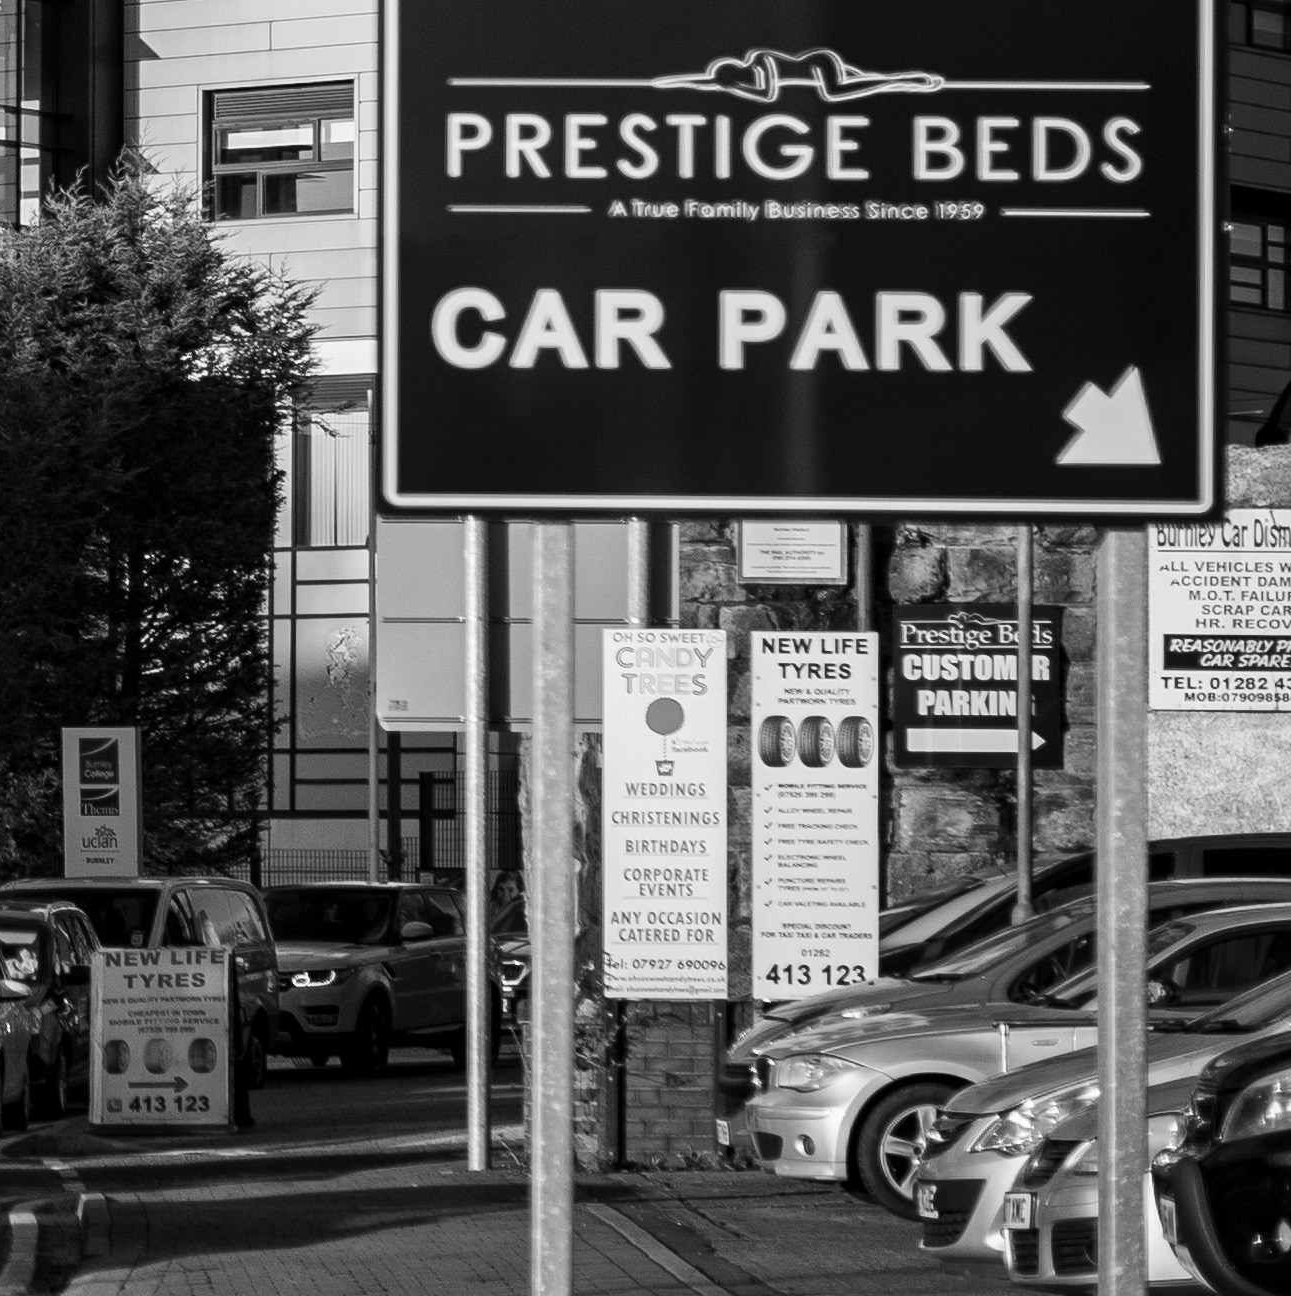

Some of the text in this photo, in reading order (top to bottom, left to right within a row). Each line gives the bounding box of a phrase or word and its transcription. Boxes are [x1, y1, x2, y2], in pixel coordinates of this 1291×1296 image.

[446, 113, 1144, 183] PRESTIGE BEDS
[608, 198, 986, 222] A True Family Business Since 1959
[431, 286, 1034, 373] CAR PARK
[1156, 522, 1216, 548] Burnley
[1221, 518, 1249, 548] Car
[1159, 561, 1189, 573] ALL
[1194, 561, 1274, 573] VEHICLES
[1170, 575, 1252, 587] ACCIDENT
[1188, 590, 1235, 601] M.O.T.
[1201, 604, 1254, 616] SCRAP
[1195, 618, 1225, 629] HR.
[612, 632, 706, 644] OH SO SWEET
[900, 623, 993, 651] Prestige
[762, 637, 869, 655] NEW LIFE
[1169, 638, 1274, 653] REASONABLY
[615, 646, 714, 669] CANDY
[1199, 653, 1235, 667] CAR
[777, 662, 852, 680] TYRES
[902, 653, 1051, 681] CUSTOMR
[621, 673, 708, 696] TREES
[1160, 676, 1203, 690] TEL:
[1209, 677, 1268, 691] 01282
[813, 688, 851, 696] QUALITY
[917, 689, 1037, 717] PARKIN
[83, 769, 115, 780] College
[625, 782, 706, 797] WEDDINGS
[611, 810, 721, 825] CHRISTENINGS
[81, 833, 119, 849] uclan
[625, 839, 707, 854] BIRTHDAYS
[85, 856, 115, 865] BURNLEY
[623, 867, 709, 882] CORPORATE
[639, 882, 694, 897] EVENTS
[610, 910, 722, 925] ANY OCCASION
[618, 927, 715, 943] CATERED FOR
[104, 948, 226, 968] NEW LIFE
[801, 948, 831, 958] 01282
[632, 958, 672, 970] 07927
[677, 959, 727, 971] 690096
[122, 972, 207, 990] TYRES
[765, 963, 866, 986] 413 123
[128, 1095, 211, 1113] 413 123
